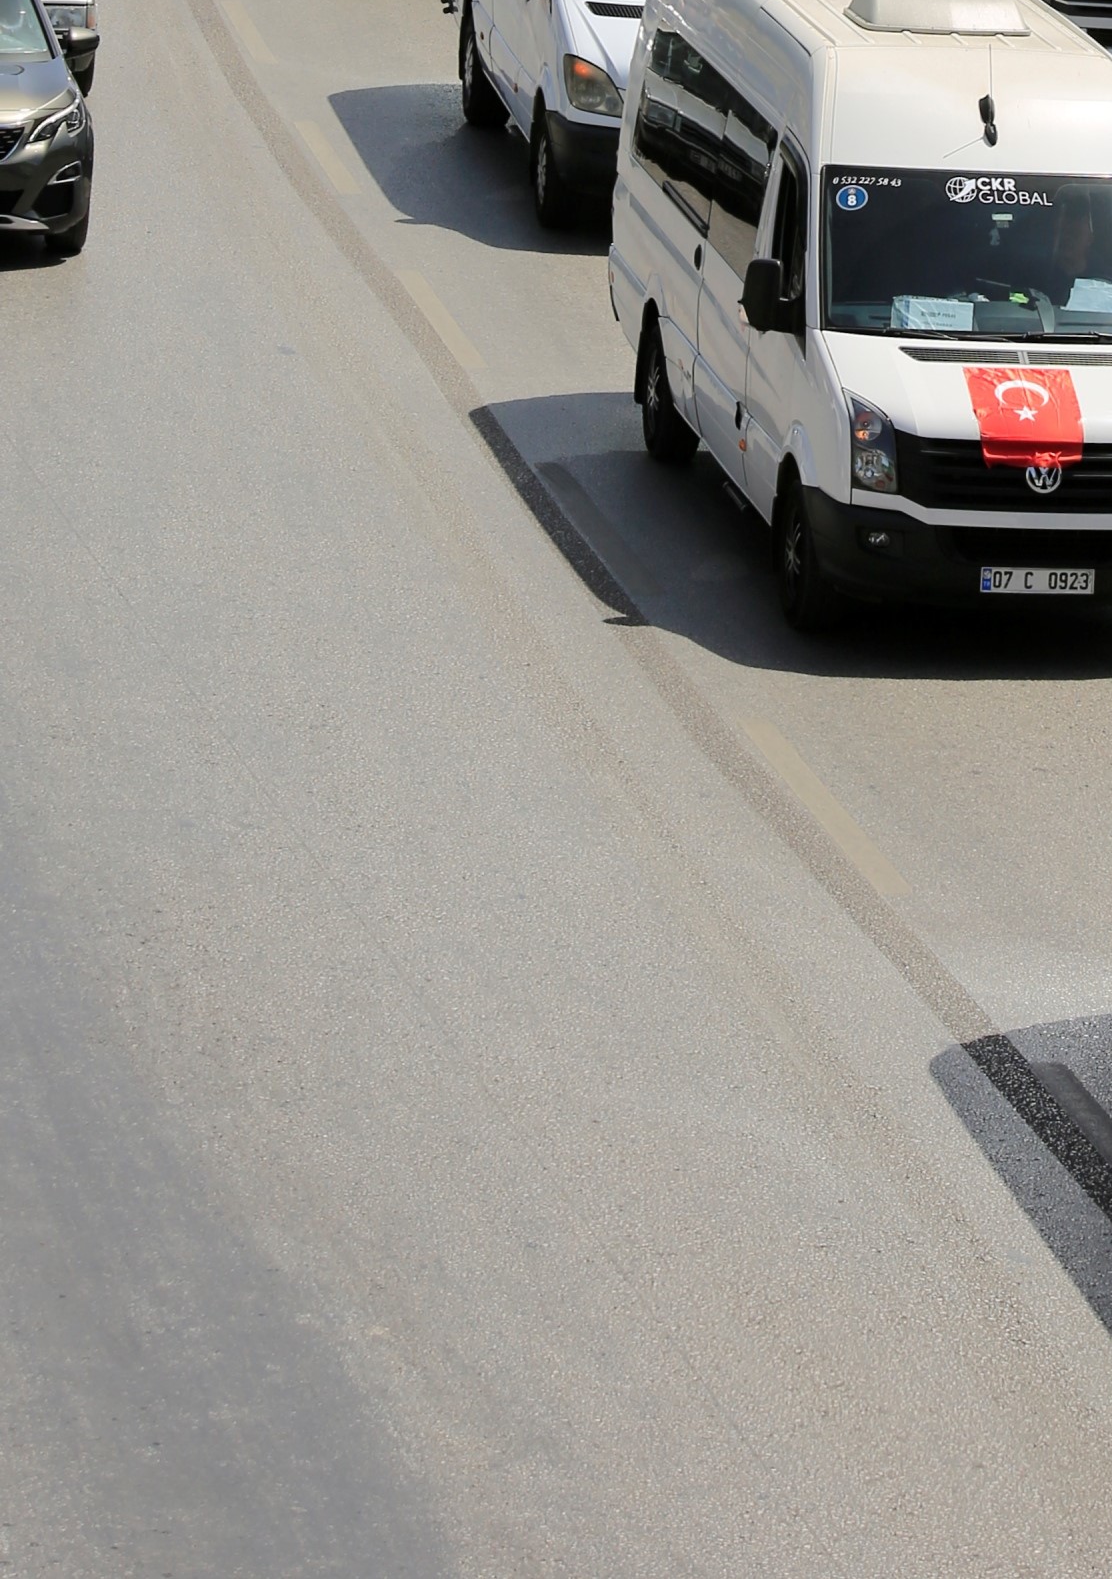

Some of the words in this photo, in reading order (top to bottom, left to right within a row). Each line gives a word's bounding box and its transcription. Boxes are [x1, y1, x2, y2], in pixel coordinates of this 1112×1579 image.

[977, 177, 1016, 191] CKR
[847, 194, 857, 206] 8
[979, 190, 1053, 206] GLOBAL
[993, 571, 1013, 589] 07
[1024, 571, 1034, 589] C
[1048, 572, 1089, 590] 0923
